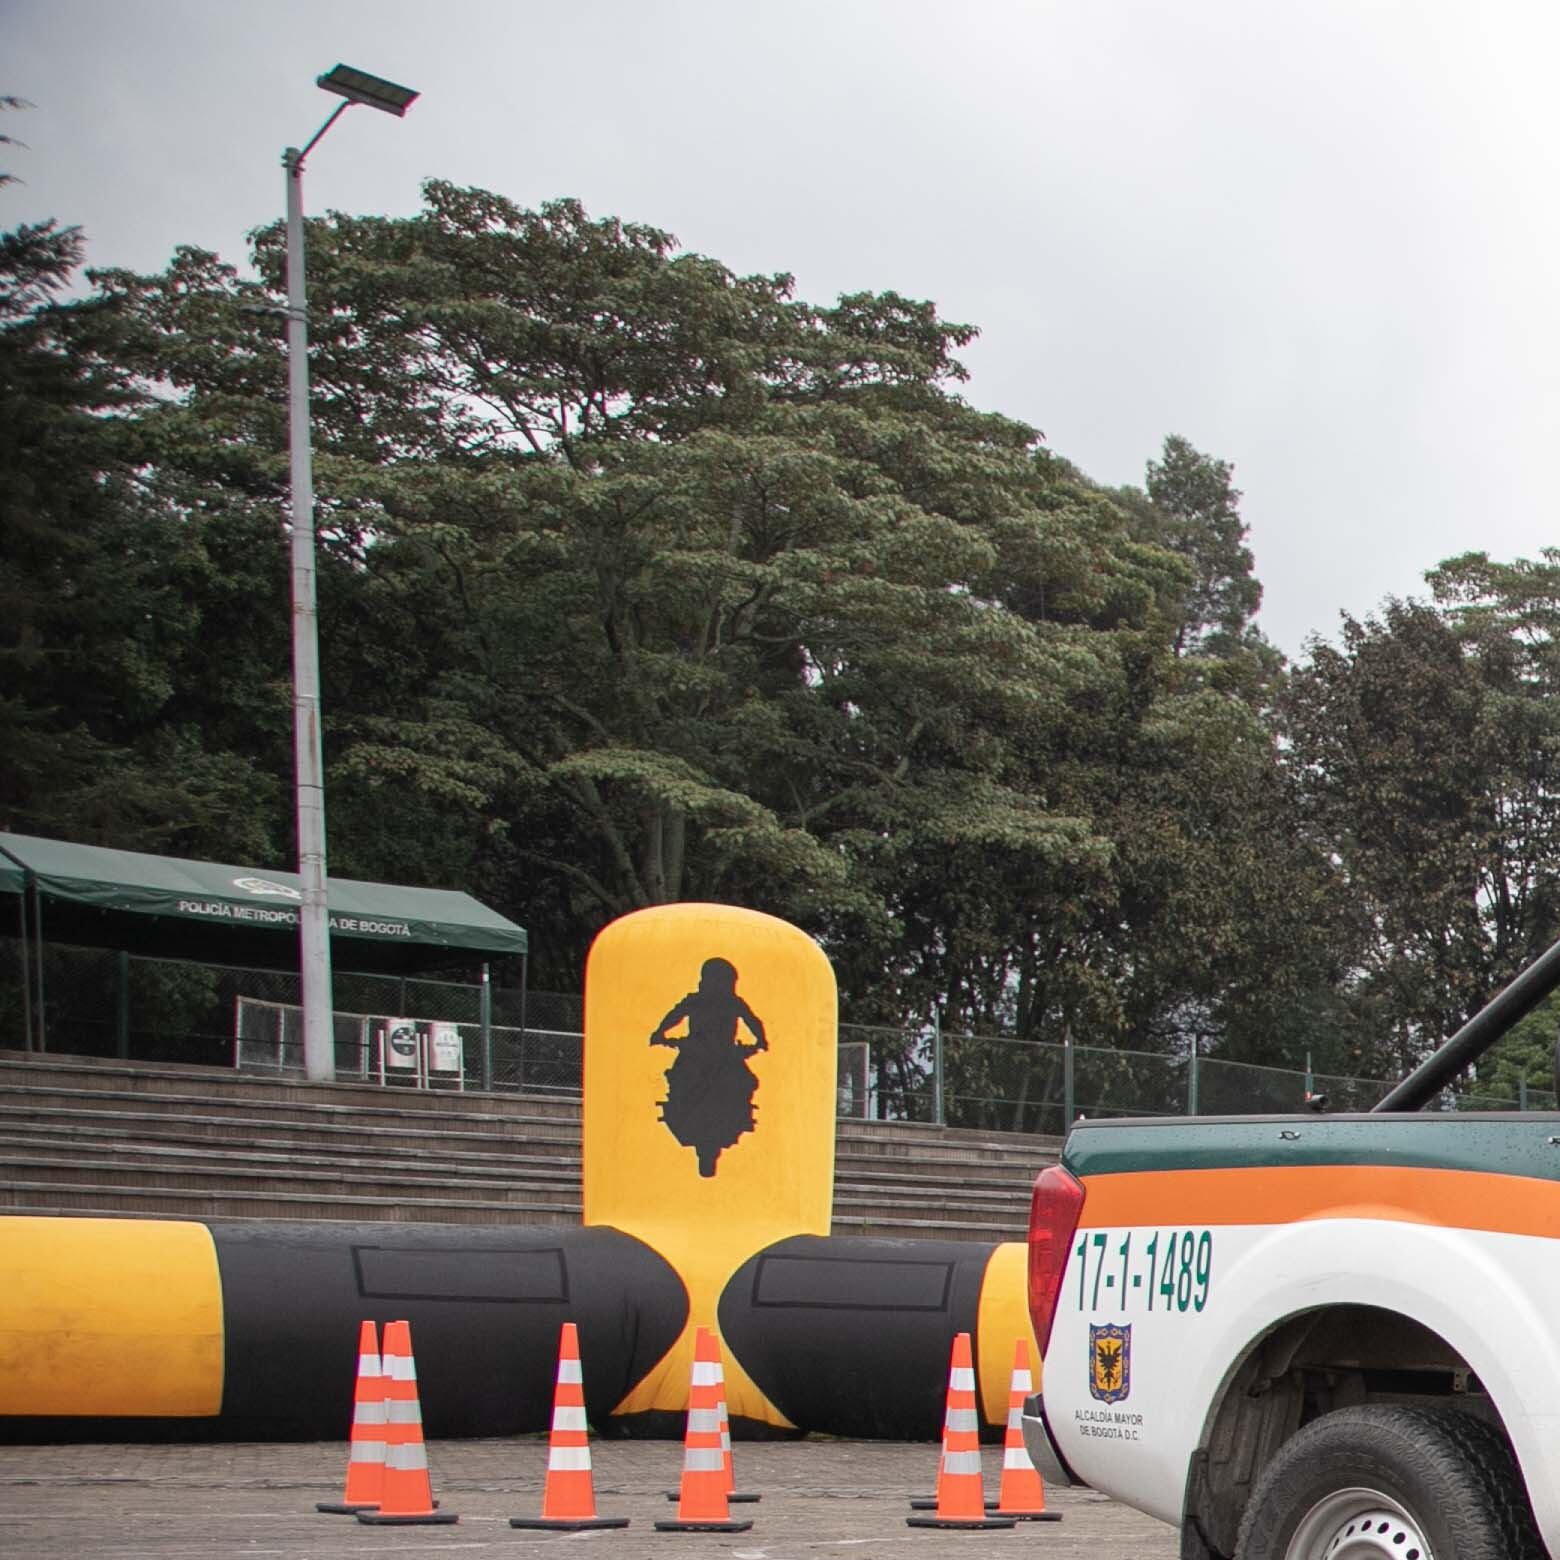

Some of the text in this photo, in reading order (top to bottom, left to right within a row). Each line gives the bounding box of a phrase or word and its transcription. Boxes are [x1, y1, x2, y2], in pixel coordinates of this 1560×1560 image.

[232, 905, 338, 928] METROPOLA
[340, 918, 358, 931] DE
[1077, 1230, 1213, 1312] 17-1-1489
[1114, 1412, 1143, 1425] MAYOR
[1080, 1425, 1091, 1436] DE
